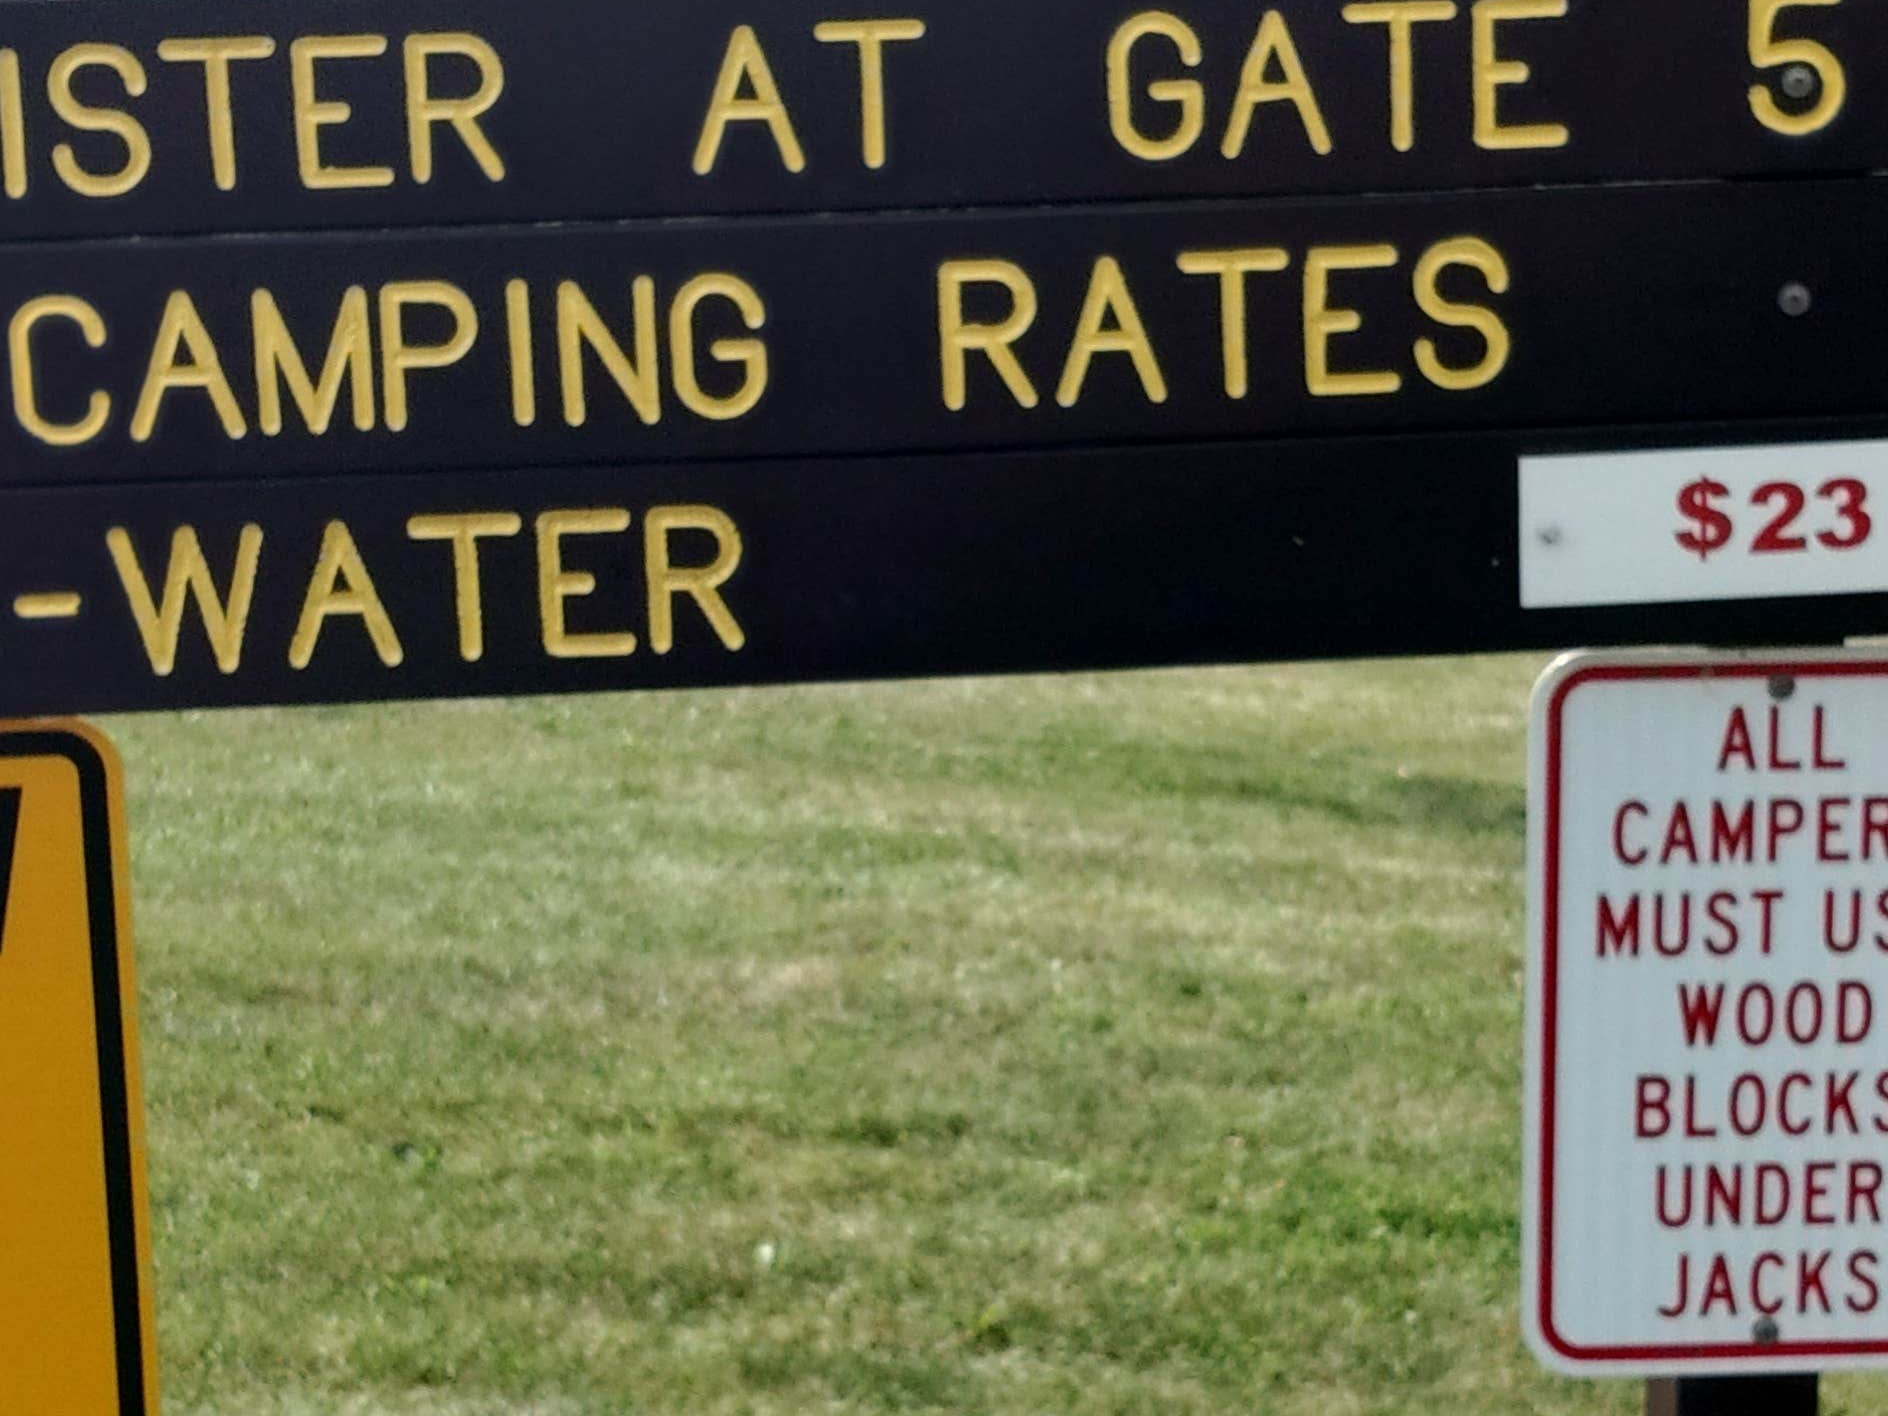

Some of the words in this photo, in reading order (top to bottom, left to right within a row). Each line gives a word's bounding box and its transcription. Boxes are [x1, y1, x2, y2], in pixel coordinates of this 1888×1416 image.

[693, 19, 925, 173] AT
[8, 272, 770, 446] CAMPING
[938, 236, 1510, 409] RATES
[1675, 476, 1872, 561] $23
[1717, 704, 1845, 771] ALL
[1595, 890, 1784, 957] MUST
[1677, 982, 1874, 1046] WOOD
[1656, 1161, 1882, 1228] UNDER
[1658, 1250, 1880, 1318] JACKS
